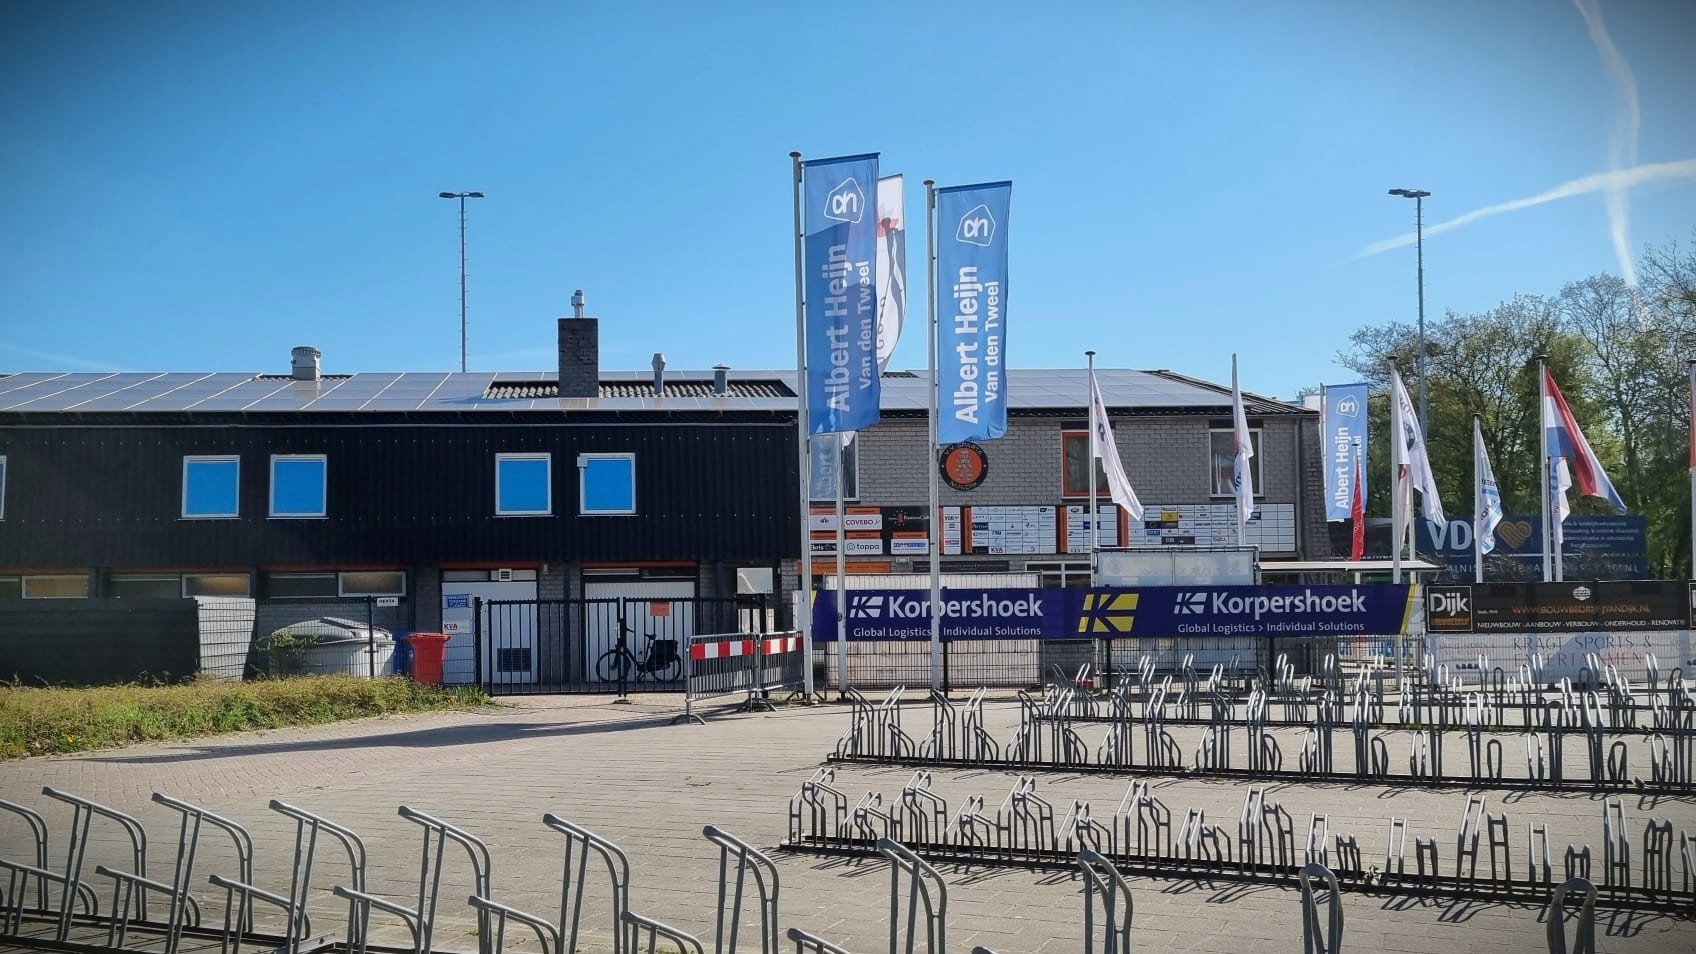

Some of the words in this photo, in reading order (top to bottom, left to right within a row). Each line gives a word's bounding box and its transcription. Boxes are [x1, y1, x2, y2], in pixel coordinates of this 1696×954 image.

[822, 244, 852, 316] Heijn
[856, 261, 871, 315] Tweel
[954, 266, 982, 334] Heijn
[985, 281, 999, 332] Tweel
[857, 319, 872, 350] den
[985, 335, 999, 366] den
[824, 325, 850, 413] Albert
[857, 357, 871, 391] Van
[954, 342, 978, 425] Albert
[985, 373, 999, 403] Van
[1335, 427, 1351, 463] Heijn
[1335, 465, 1349, 509] Albert
[857, 543, 880, 552] toppa
[1212, 589, 1367, 620] Korpershoek
[1430, 592, 1469, 616] Dijk
[444, 623, 458, 631] KVA
[853, 627, 886, 637] Global
[889, 627, 932, 639] Logistics
[943, 626, 992, 636] Individual
[995, 626, 1041, 636] Solutions
[1178, 623, 1210, 633] Global
[1213, 623, 1255, 635] Logistics
[1267, 622, 1315, 632] Individual
[1318, 621, 1365, 631] Solutions
[1478, 621, 1521, 629] NIEUWBOUW
[1526, 621, 1561, 629] AANBOUW
[1565, 620, 1599, 628] VERBOUW
[1514, 635, 1564, 650] KRAGT
[1575, 635, 1633, 650] SPORTS
[1644, 634, 1652, 648] &
